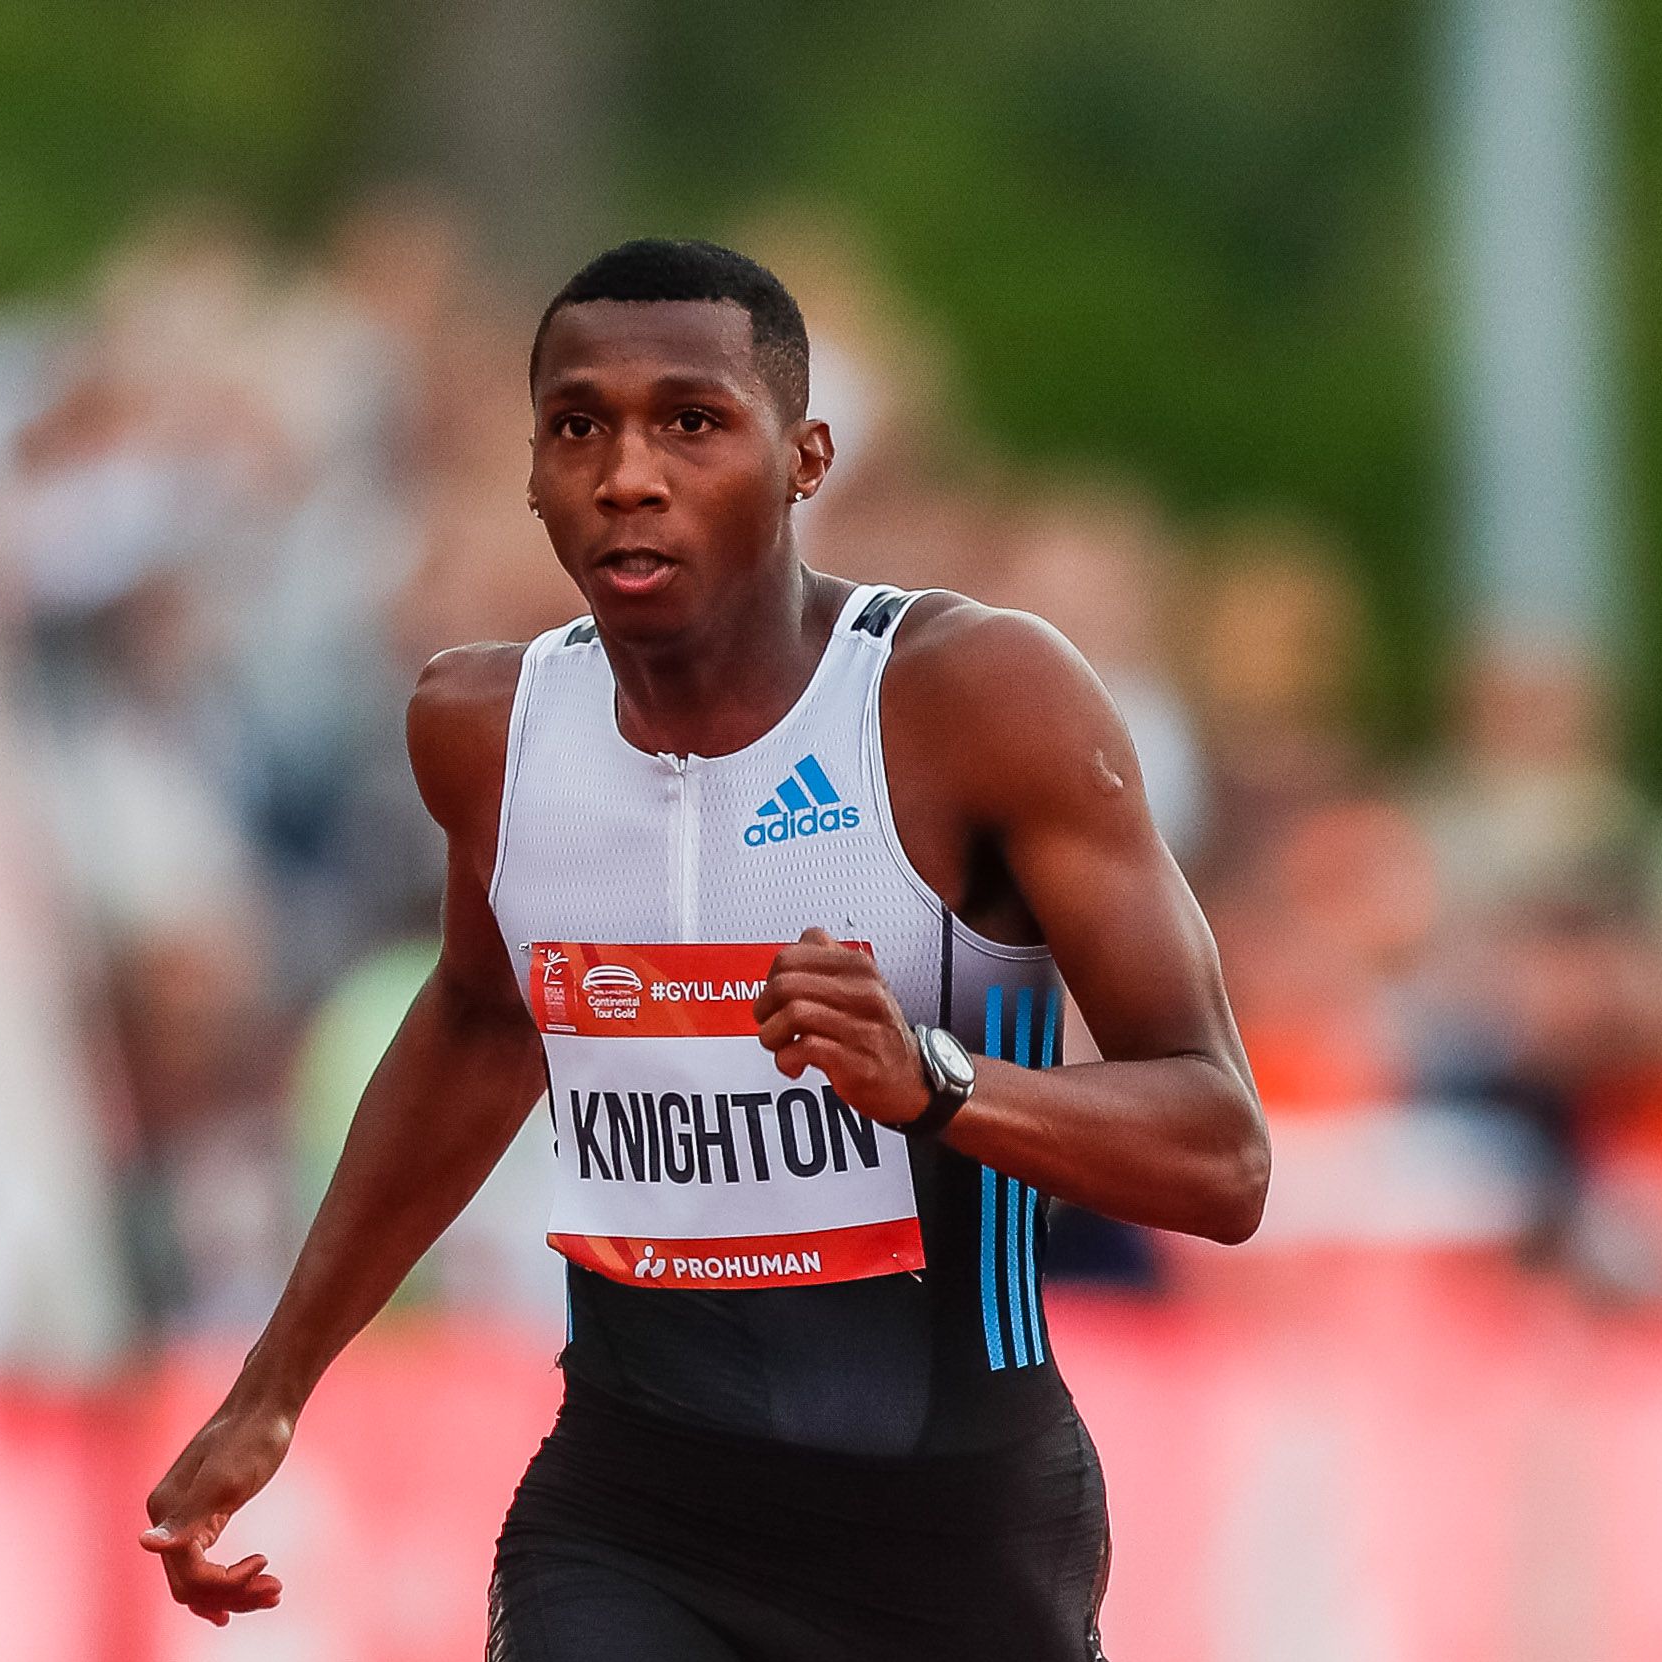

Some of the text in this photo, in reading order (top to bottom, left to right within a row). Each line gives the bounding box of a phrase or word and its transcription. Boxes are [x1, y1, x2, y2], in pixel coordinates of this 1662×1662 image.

[744, 801, 860, 848] adidas
[587, 995, 640, 1007] Continental
[593, 1008, 636, 1018] Tour Gold
[570, 1085, 881, 1183] KNIGHTON
[673, 1251, 822, 1279] PROHUMAN
